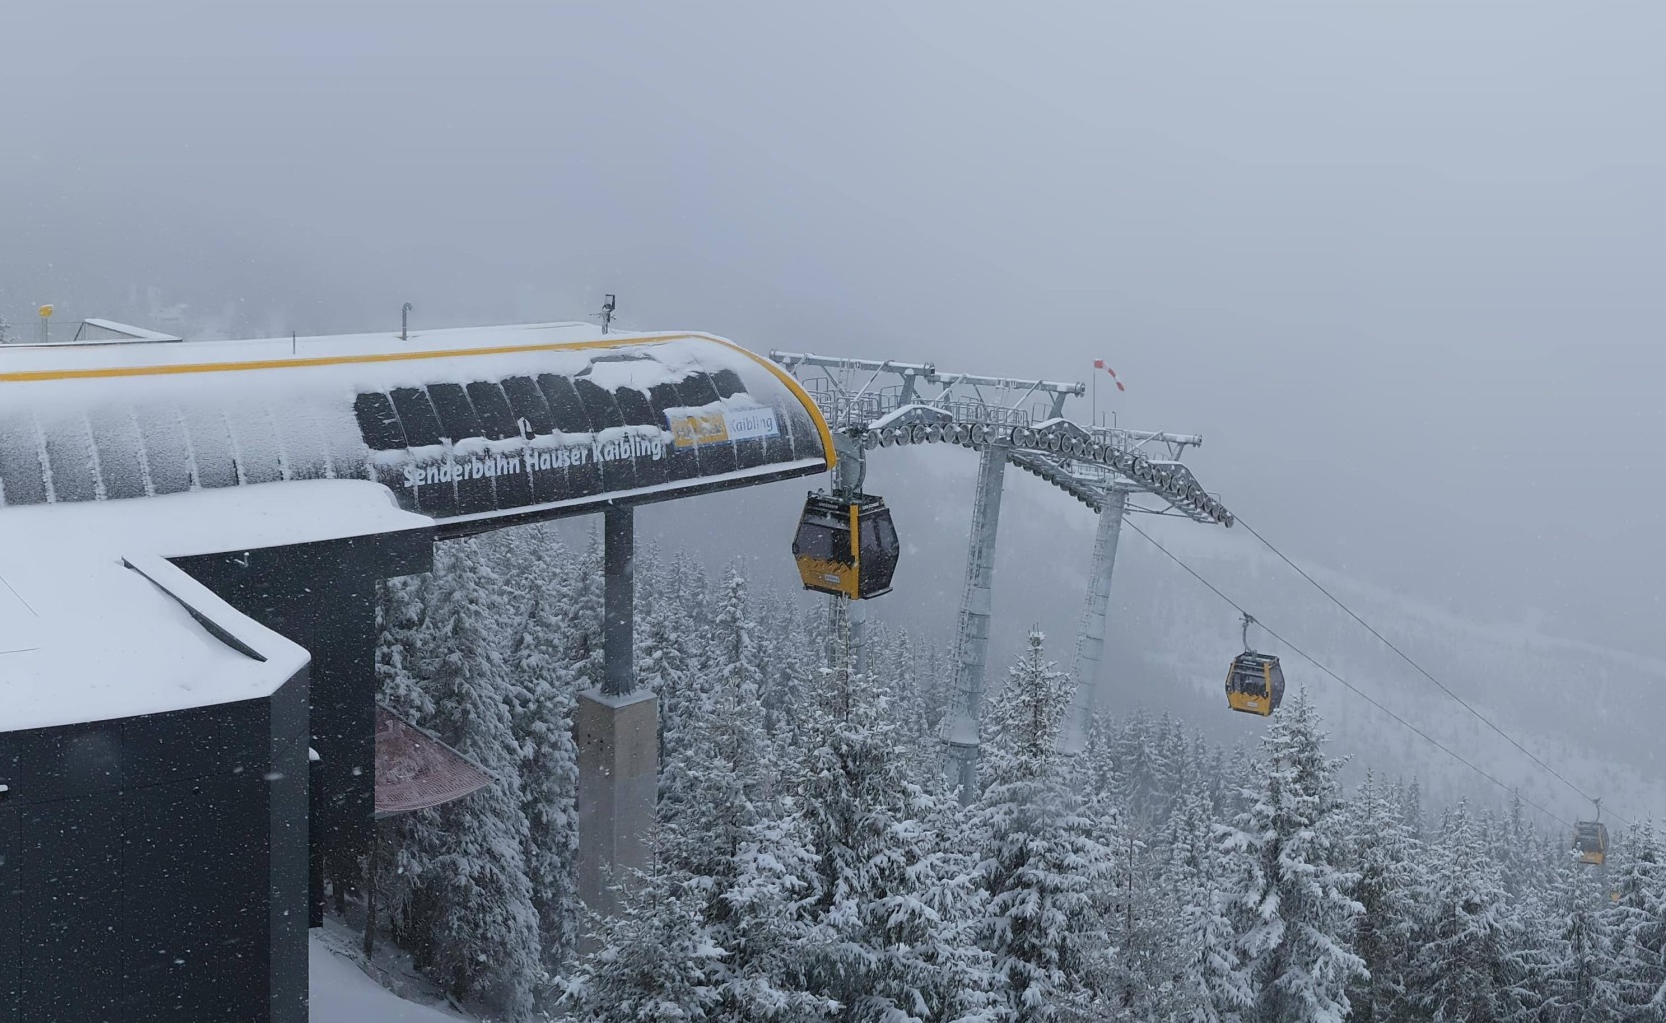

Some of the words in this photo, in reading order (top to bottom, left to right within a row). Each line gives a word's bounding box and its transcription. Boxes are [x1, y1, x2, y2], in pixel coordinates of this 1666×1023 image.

[403, 455, 520, 487] Senderbahn
[523, 449, 588, 472] Hauser
[593, 435, 662, 462] Kaibling
